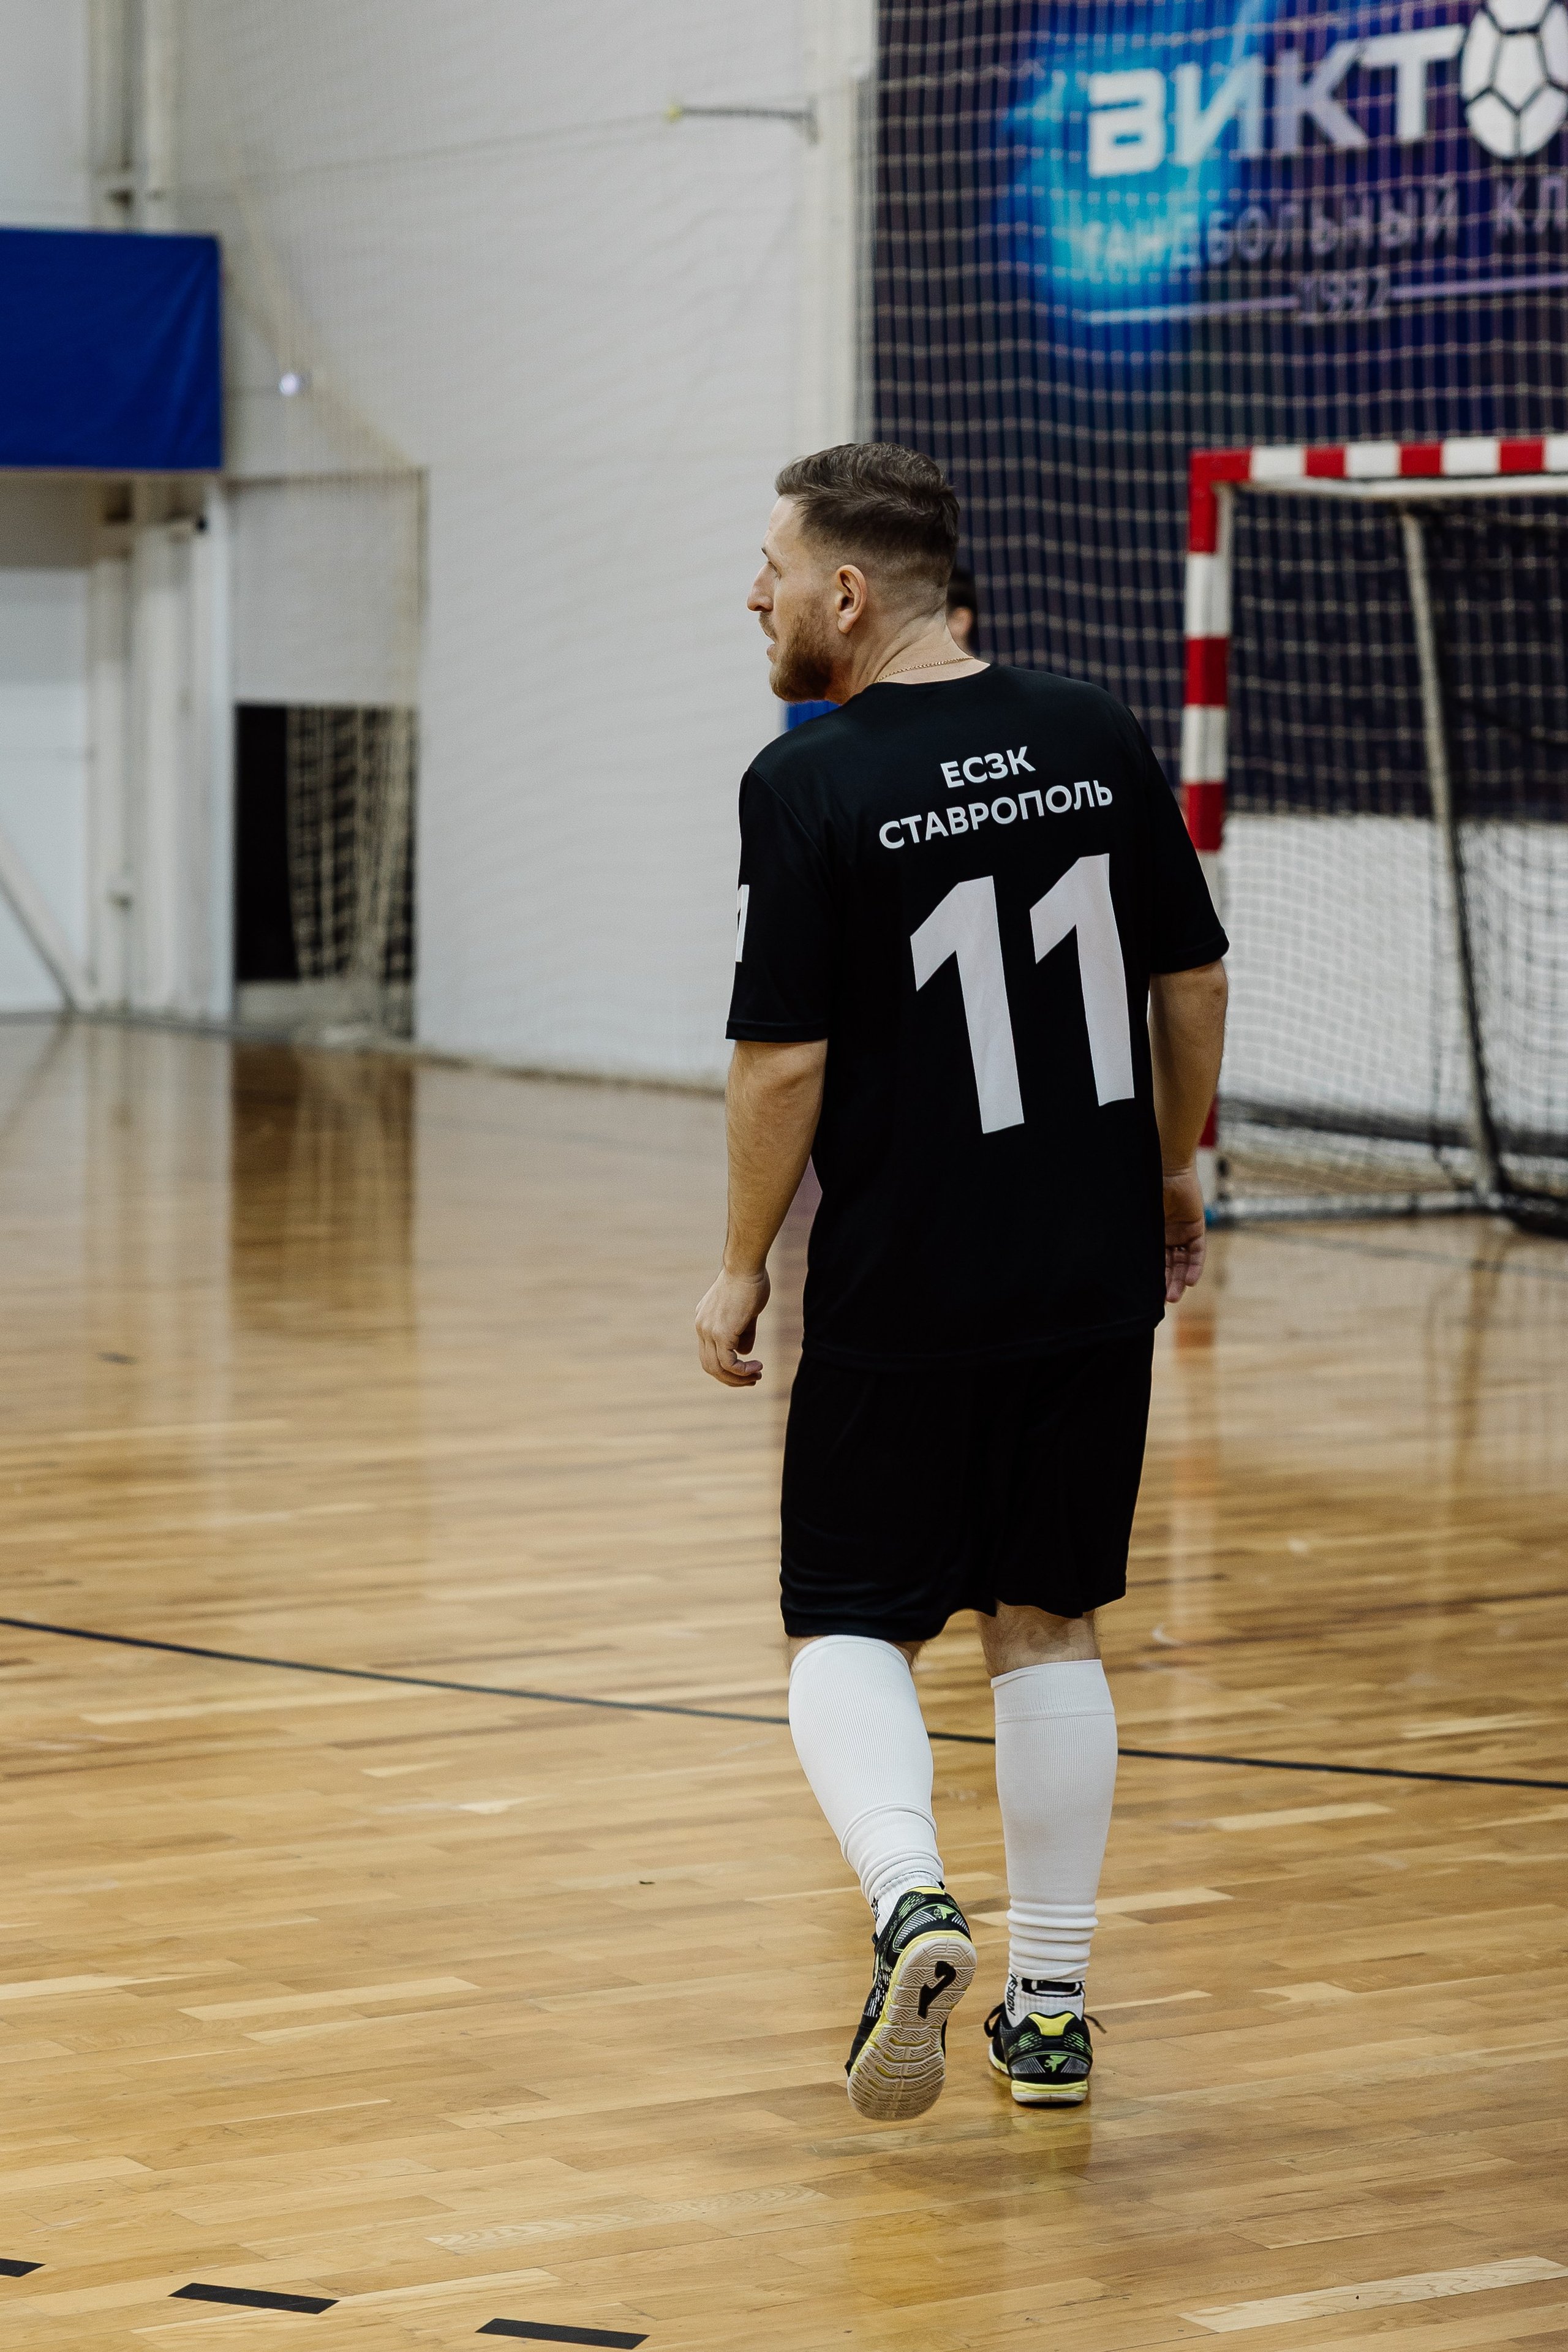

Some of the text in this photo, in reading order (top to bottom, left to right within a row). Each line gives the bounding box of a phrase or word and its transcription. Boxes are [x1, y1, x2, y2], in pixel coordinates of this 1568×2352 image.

[940, 745, 1036, 788] ЕСЗК
[878, 780, 1114, 850] СТАВРОПОЛЬ
[910, 853, 1135, 1134] 11
